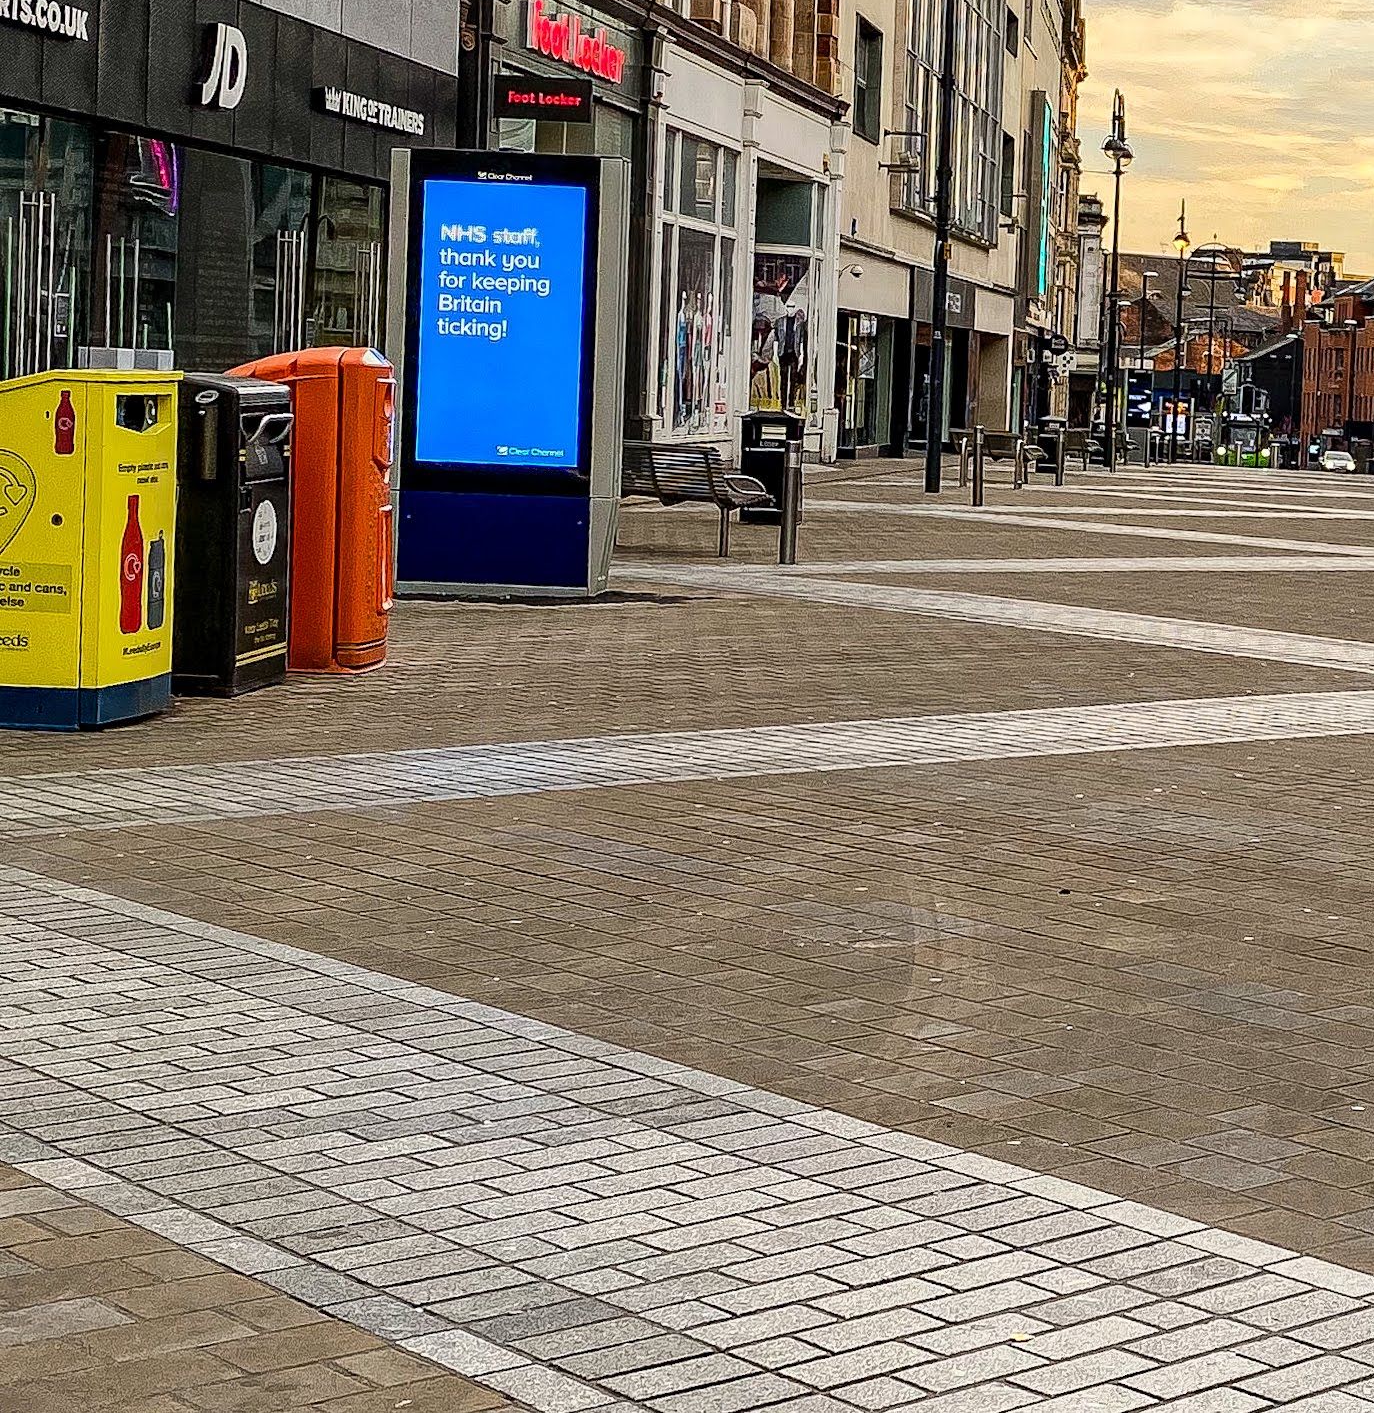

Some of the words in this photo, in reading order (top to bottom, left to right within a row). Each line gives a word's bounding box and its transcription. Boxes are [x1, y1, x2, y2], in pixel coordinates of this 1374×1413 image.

[202, 22, 248, 109] JD
[508, 90, 536, 104] Foot
[538, 92, 582, 106] Locker
[342, 91, 368, 120] KING
[367, 99, 378, 123] OF
[378, 102, 424, 135] TRAINERS
[440, 224, 487, 243] NHS
[492, 228, 541, 248] staff,
[439, 248, 497, 267] thank
[502, 254, 540, 272] you
[439, 270, 467, 288] for
[471, 272, 550, 297] keeping
[438, 293, 502, 314] Britain
[437, 317, 508, 341] ticking!
[9, 582, 31, 593] and
